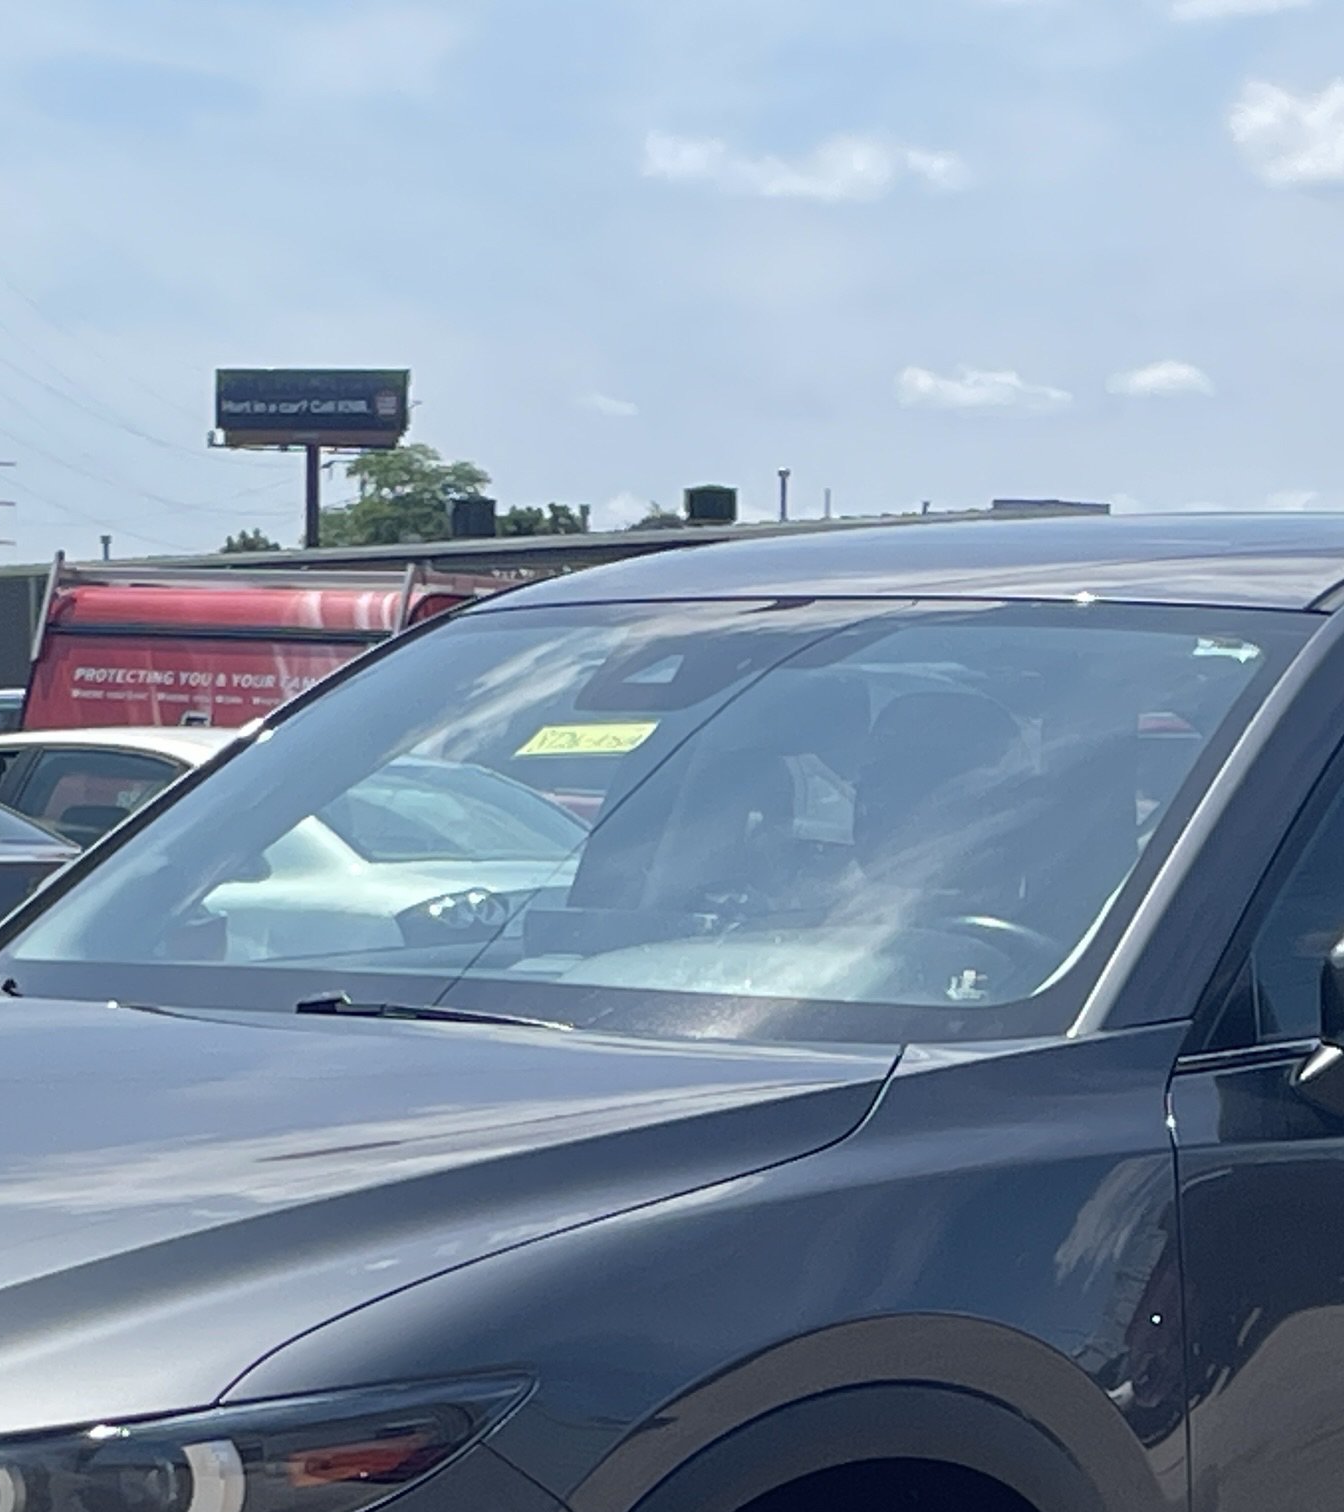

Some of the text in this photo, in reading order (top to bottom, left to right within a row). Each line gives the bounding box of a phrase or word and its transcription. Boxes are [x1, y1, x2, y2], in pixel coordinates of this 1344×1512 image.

[74, 667, 175, 686] PROTECTING
[179, 671, 211, 687] YOU
[231, 674, 275, 689] YOUR
